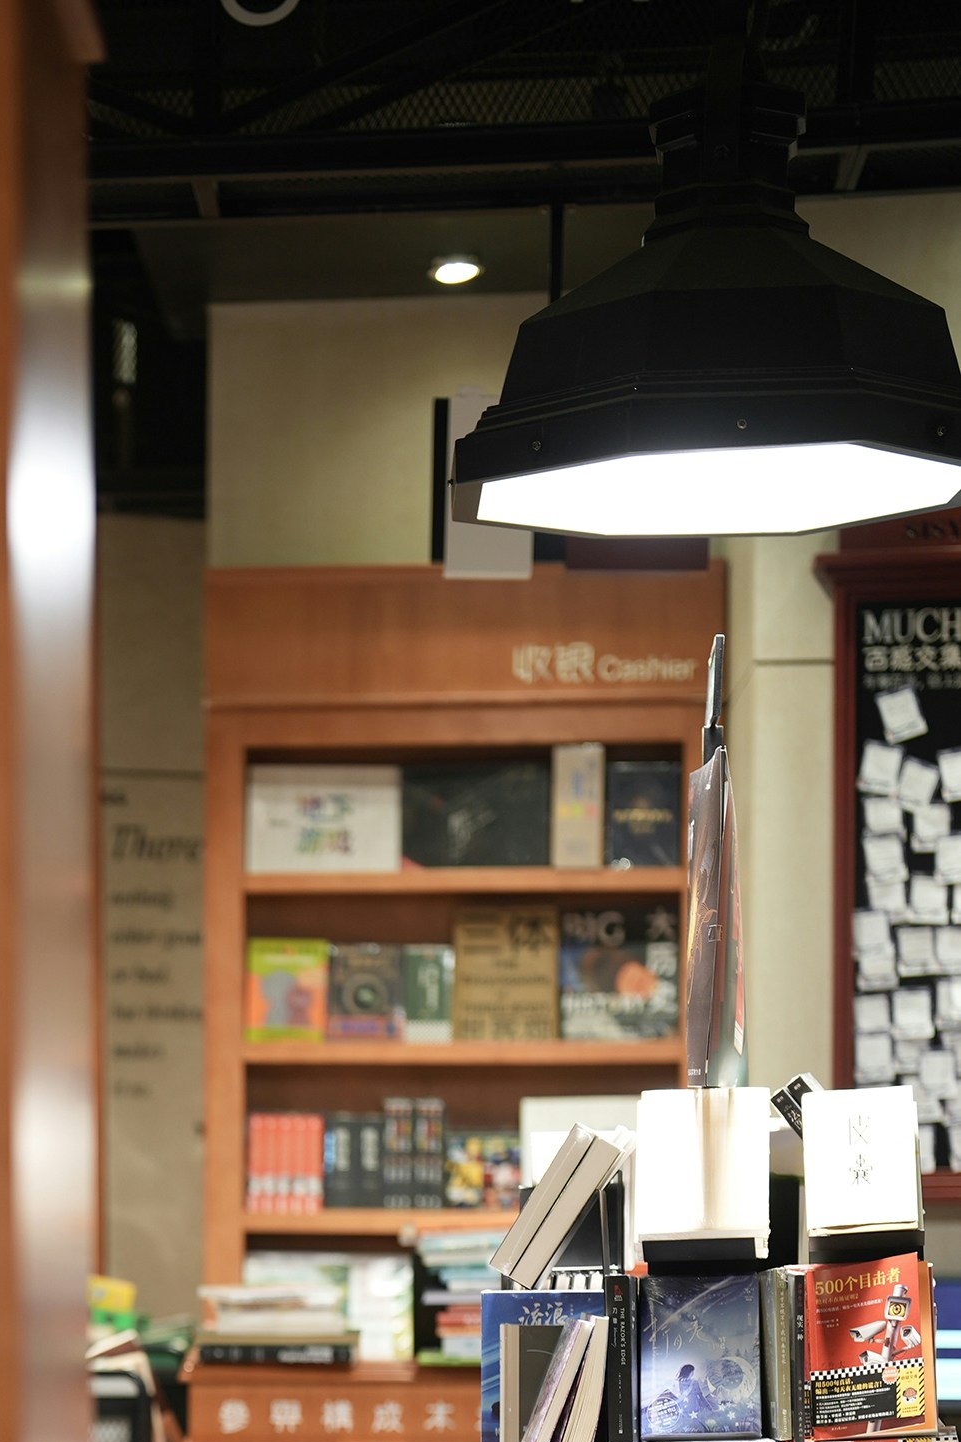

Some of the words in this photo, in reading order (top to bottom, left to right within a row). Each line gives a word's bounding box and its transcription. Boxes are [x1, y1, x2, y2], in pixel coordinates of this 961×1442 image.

[863, 607, 961, 645] MUCH
[512, 641, 595, 684] 收银
[598, 655, 698, 682] Cashier
[815, 1267, 900, 1296] 500个目击者
